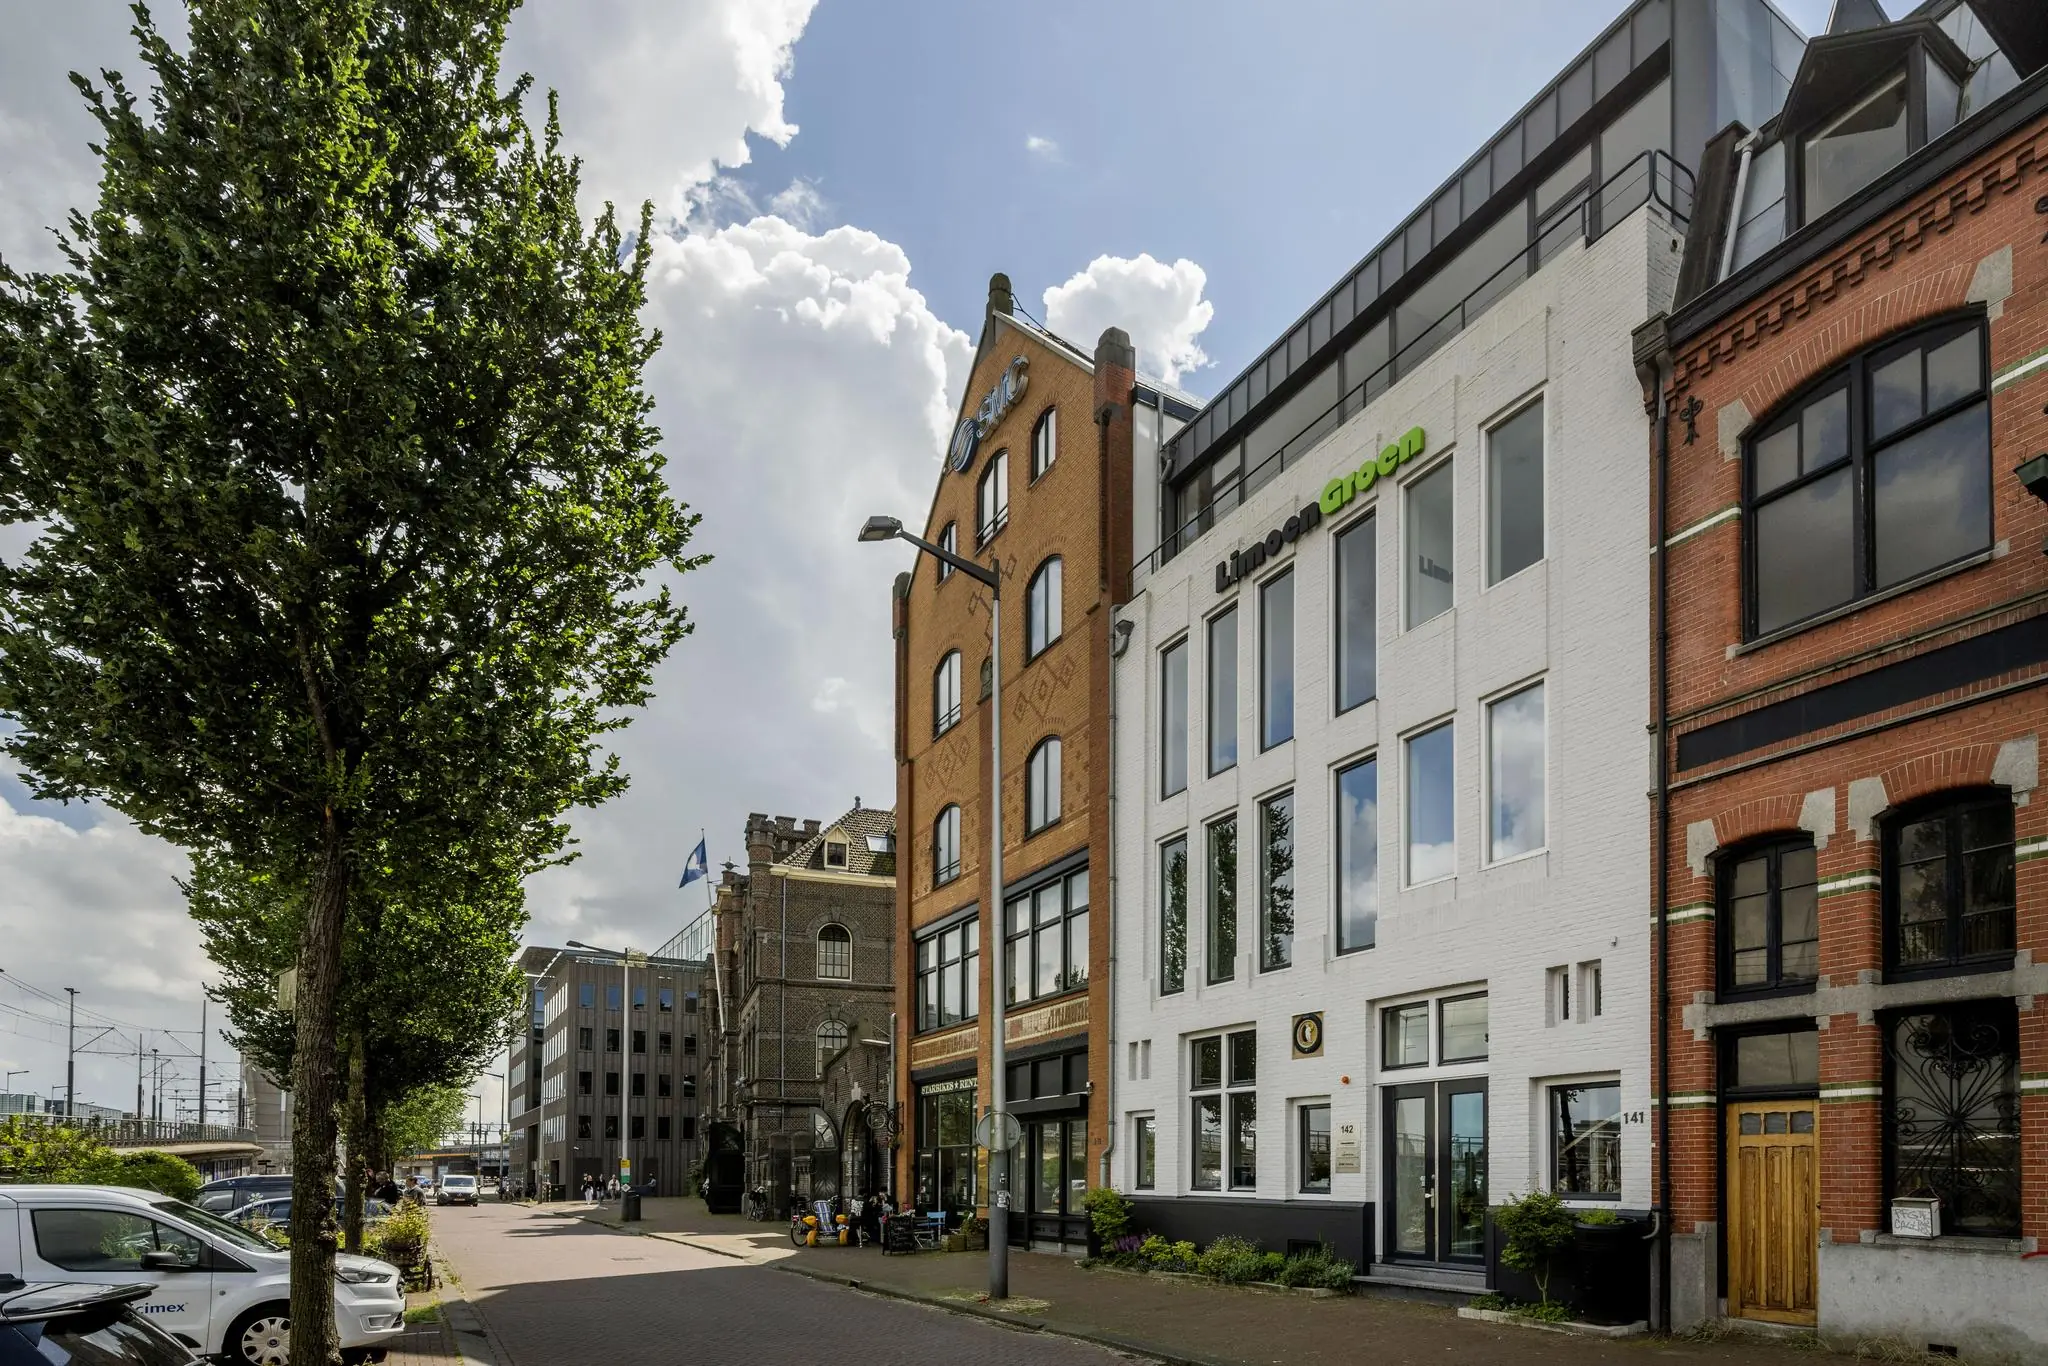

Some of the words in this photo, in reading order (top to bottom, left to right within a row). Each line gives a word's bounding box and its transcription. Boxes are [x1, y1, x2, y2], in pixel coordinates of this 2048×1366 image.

[921, 1081, 954, 1095] STARBIKES
[1623, 1111, 1644, 1124] 141
[1340, 1124, 1354, 1134] 142
